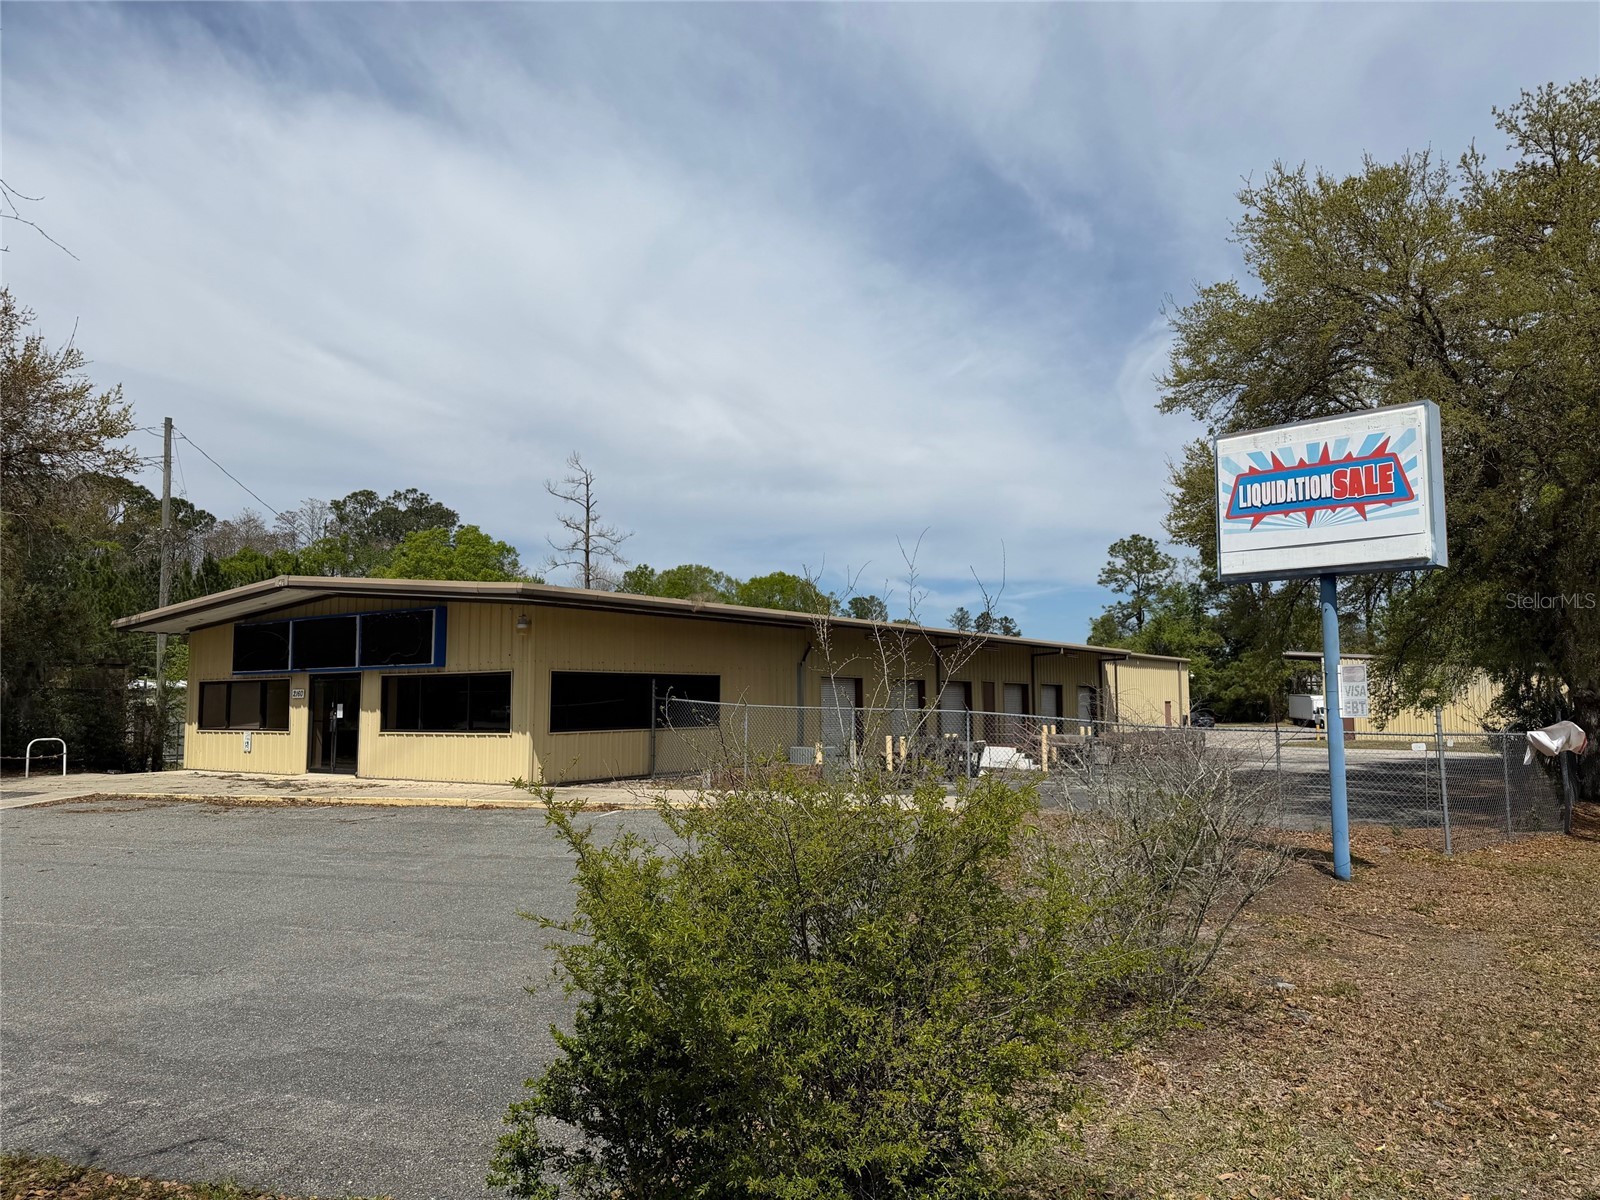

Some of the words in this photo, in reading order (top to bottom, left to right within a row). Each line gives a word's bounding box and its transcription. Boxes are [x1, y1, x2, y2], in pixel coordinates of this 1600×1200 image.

[1238, 473, 1332, 508] LIQUIDATION
[1331, 461, 1394, 499] SALE
[1345, 685, 1367, 697] VISA
[1344, 701, 1366, 715] EBT
